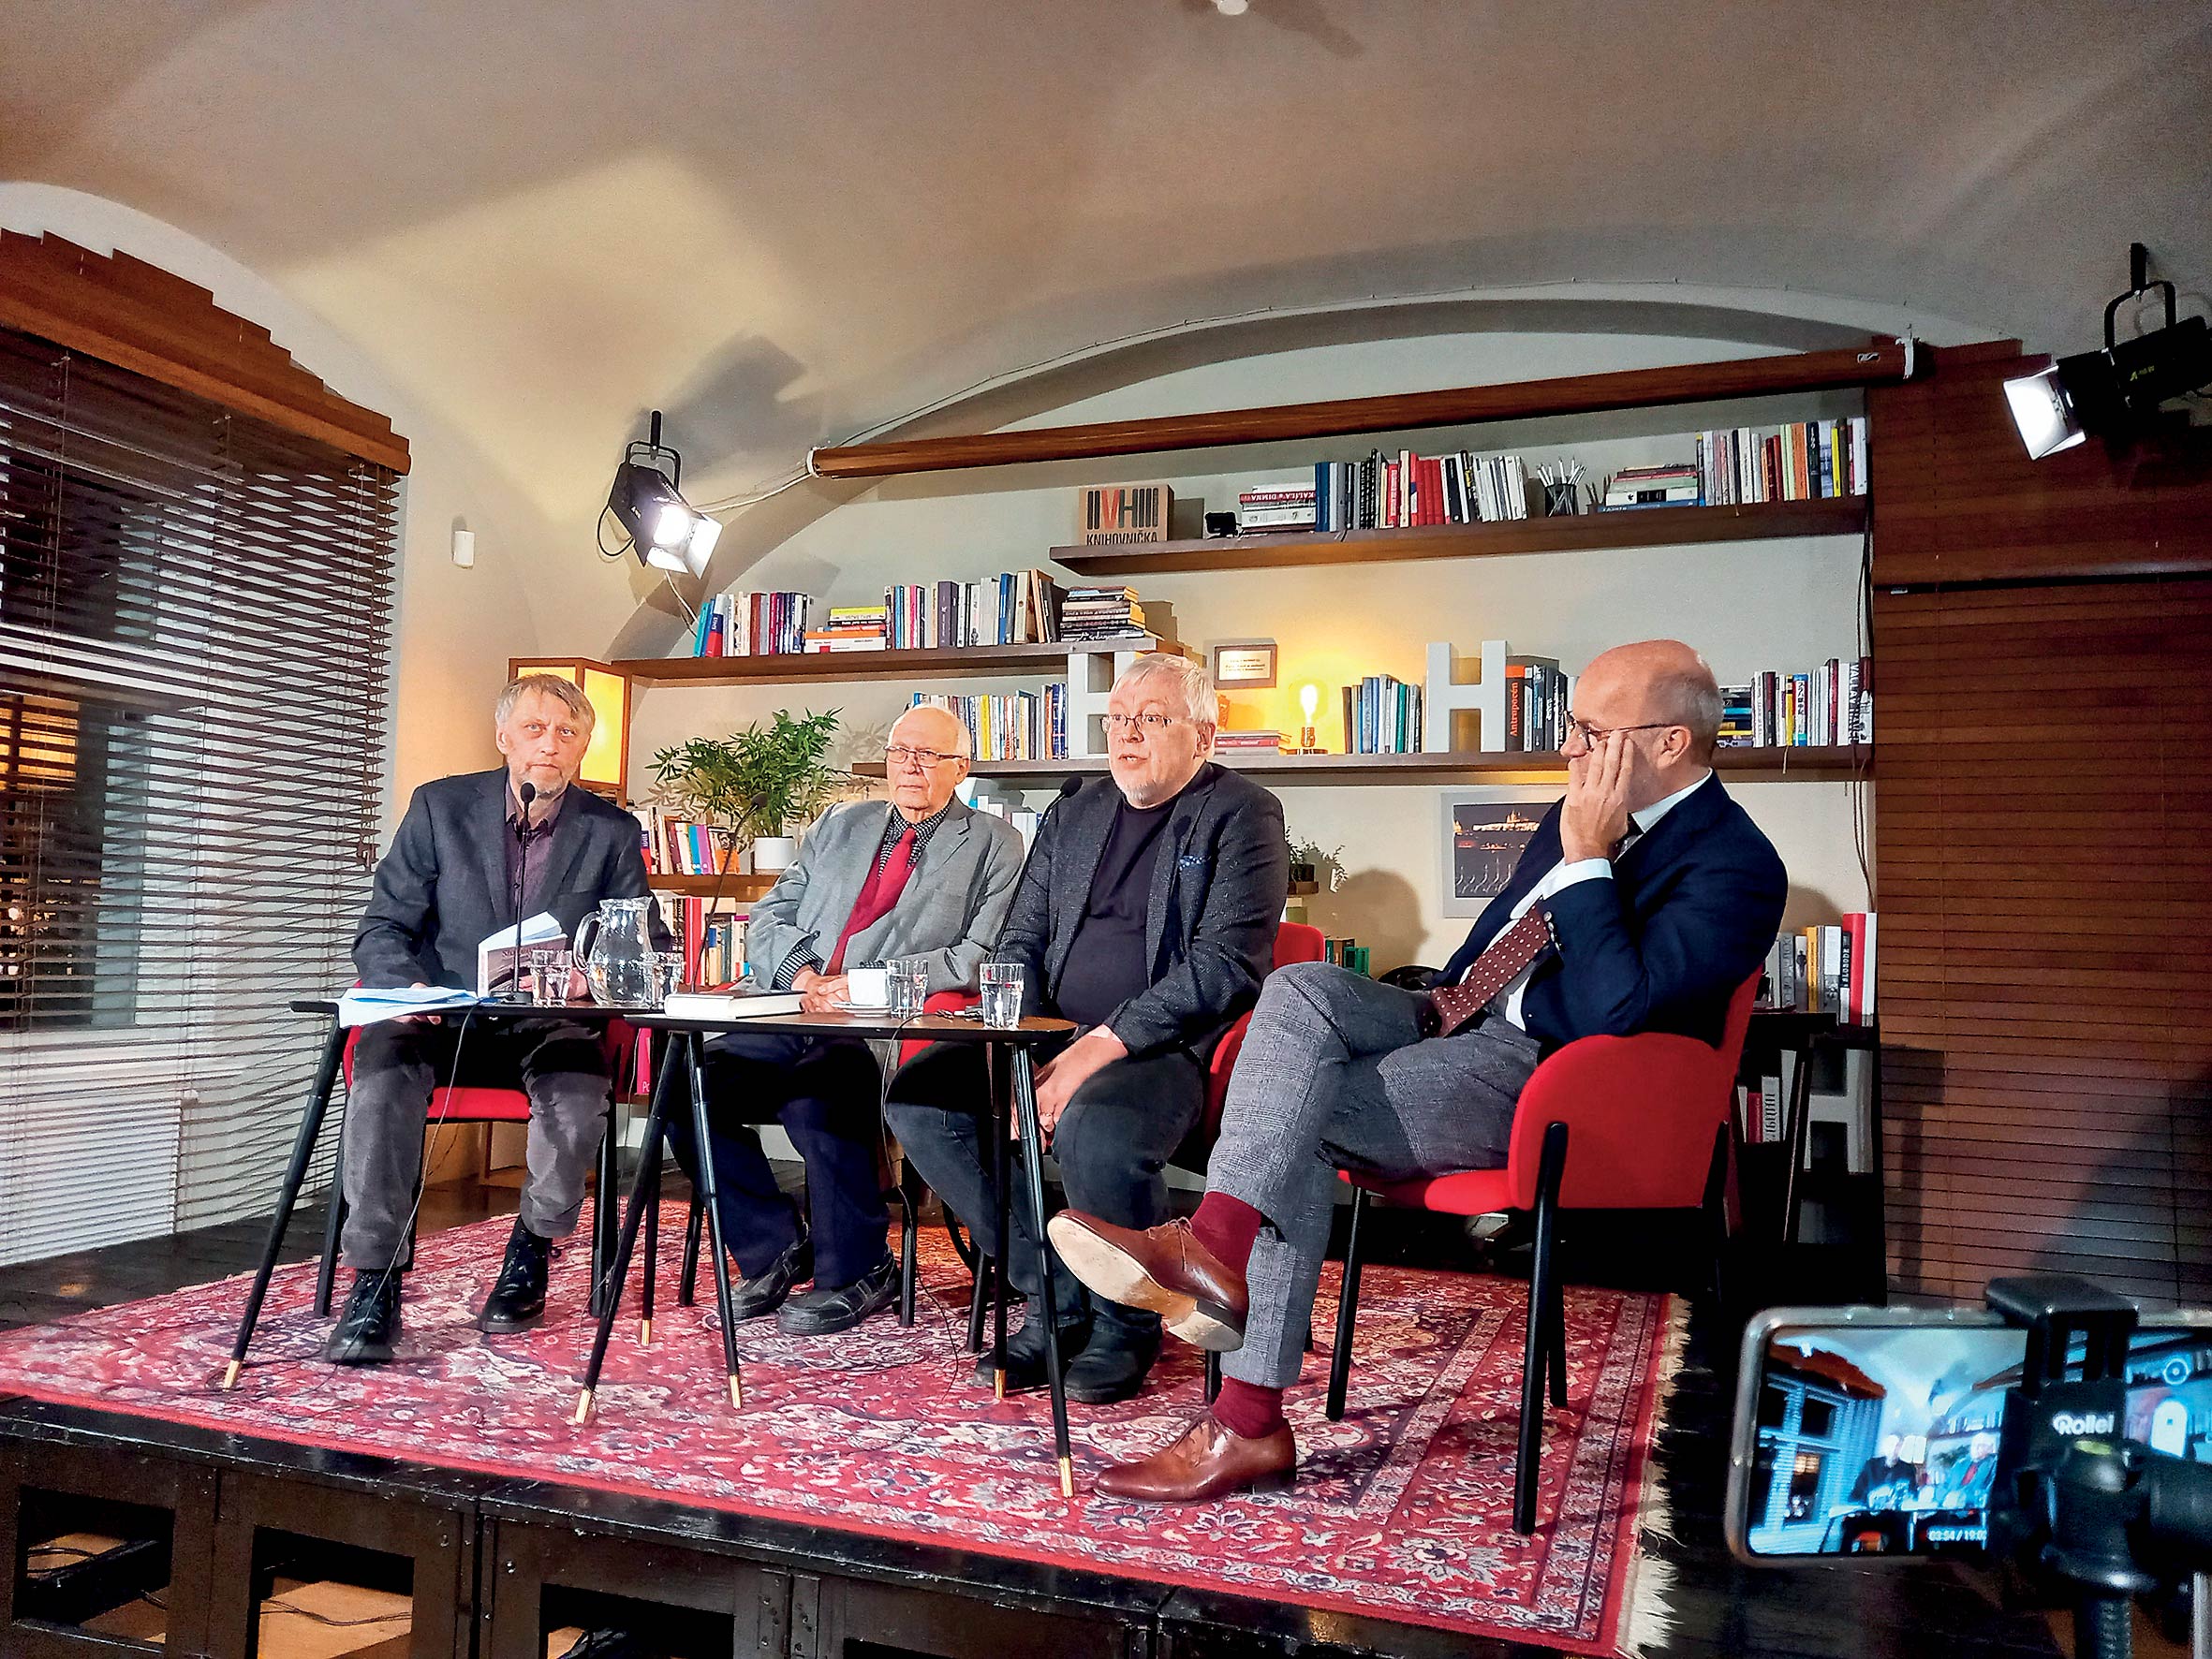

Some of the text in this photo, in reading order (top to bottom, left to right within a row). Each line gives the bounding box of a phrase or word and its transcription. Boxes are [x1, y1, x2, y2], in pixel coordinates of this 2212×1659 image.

[1086, 530, 1158, 546] KNIHOVNIČKA
[1510, 682, 1520, 737] Antropocén
[2052, 1413, 2115, 1435] Rollei
